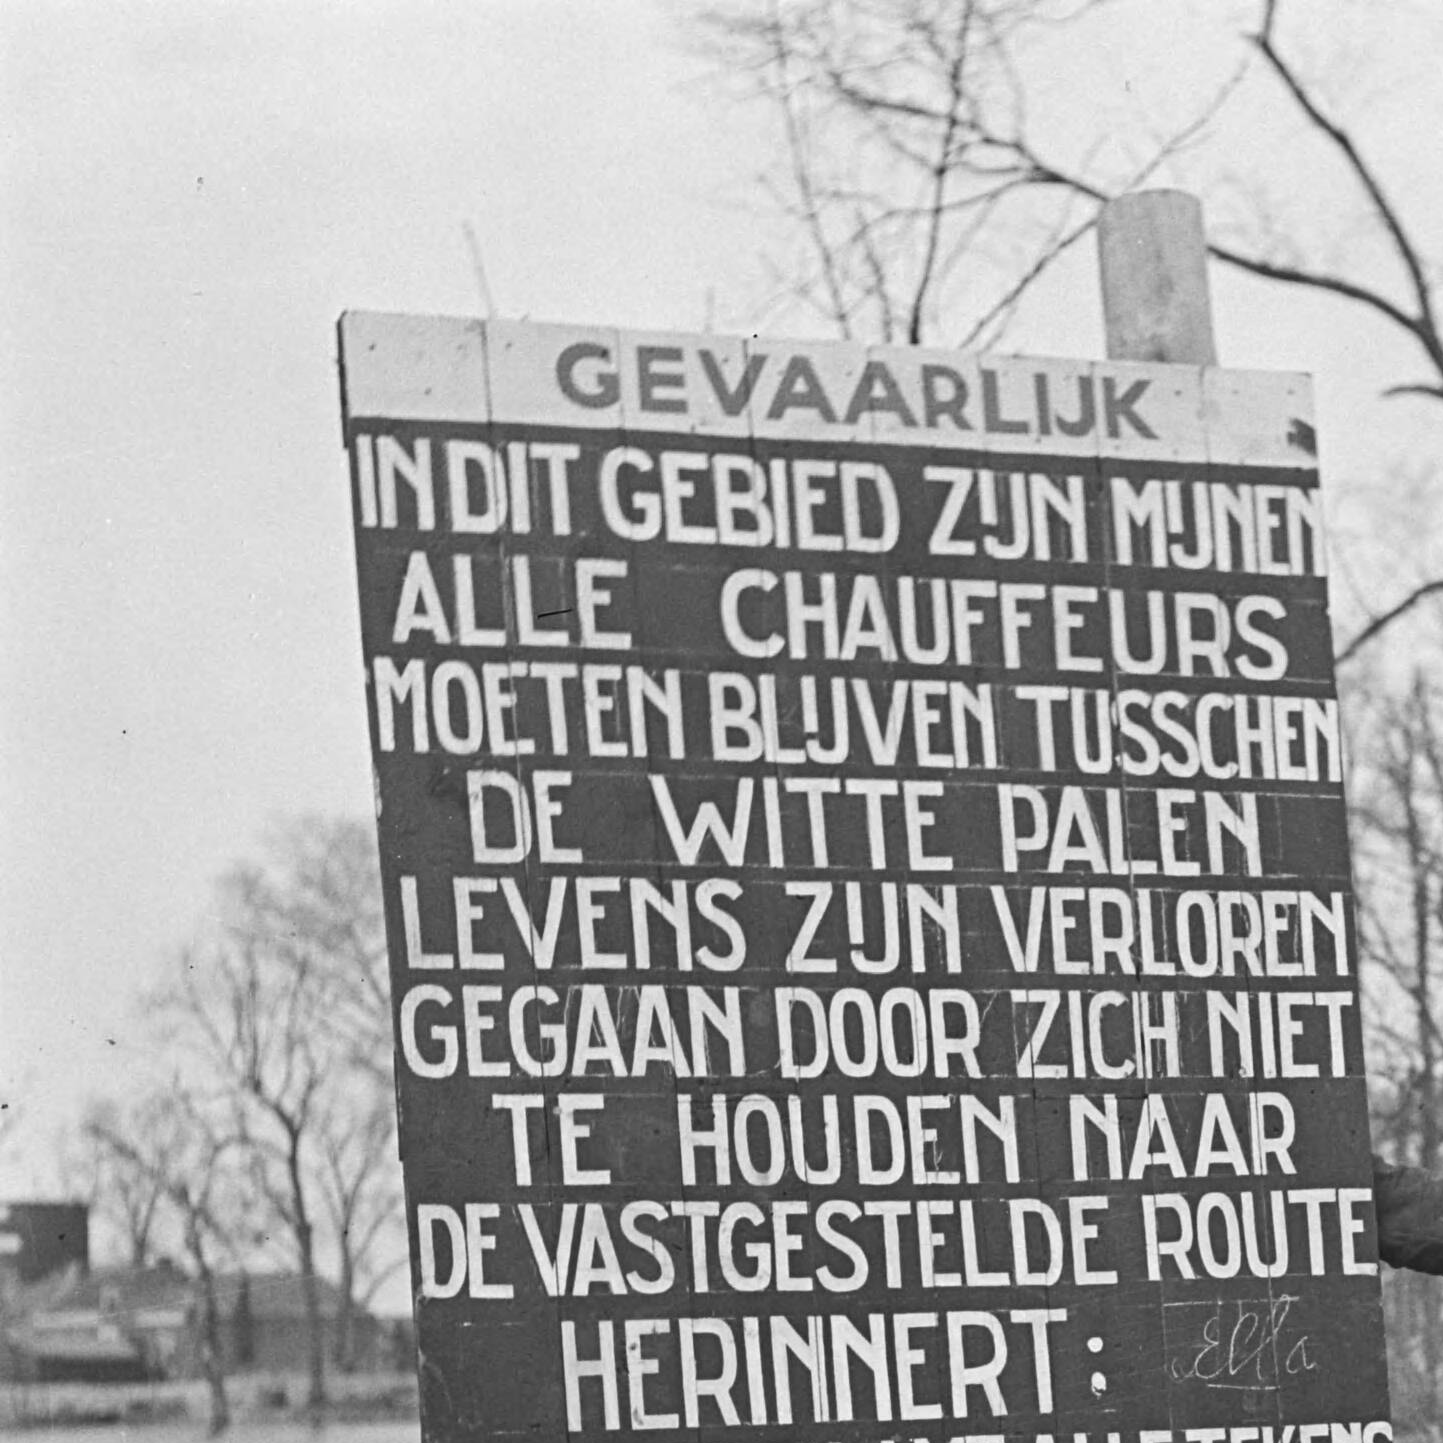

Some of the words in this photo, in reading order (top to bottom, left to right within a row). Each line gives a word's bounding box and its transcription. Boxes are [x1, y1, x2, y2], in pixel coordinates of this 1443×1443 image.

[556, 343, 1158, 439] GEVAARLIJK
[357, 435, 435, 530] IN
[445, 440, 580, 535] DIT
[600, 447, 899, 552] GEBIED
[924, 466, 1087, 562] ZIJN
[1110, 476, 1329, 577] MIJNEN
[393, 552, 631, 650] ALLE
[719, 569, 1288, 681] CHAUFFEURS
[374, 657, 684, 759] MOETEN
[709, 672, 997, 769] BLIJVEN
[1015, 685, 1343, 782] TUSSCHEN
[467, 771, 582, 863] DE
[648, 775, 953, 870] WITTE
[998, 784, 1262, 877] PALEN
[401, 877, 746, 971] LEVENS
[785, 882, 961, 974] ZIJN
[990, 885, 1348, 977] VERLOREN
[401, 984, 745, 1078] GEGAAN
[775, 987, 985, 1081] DOOR
[1010, 990, 1180, 1079] ZICH
[1207, 990, 1353, 1078] NIET
[492, 1094, 610, 1186] TE
[678, 1094, 1020, 1185] HOUDEN
[1070, 1092, 1296, 1181] NAAR
[418, 1204, 514, 1298] DE
[518, 1196, 1118, 1296] VASTGESTELDE
[1142, 1188, 1377, 1281] ROUTE
